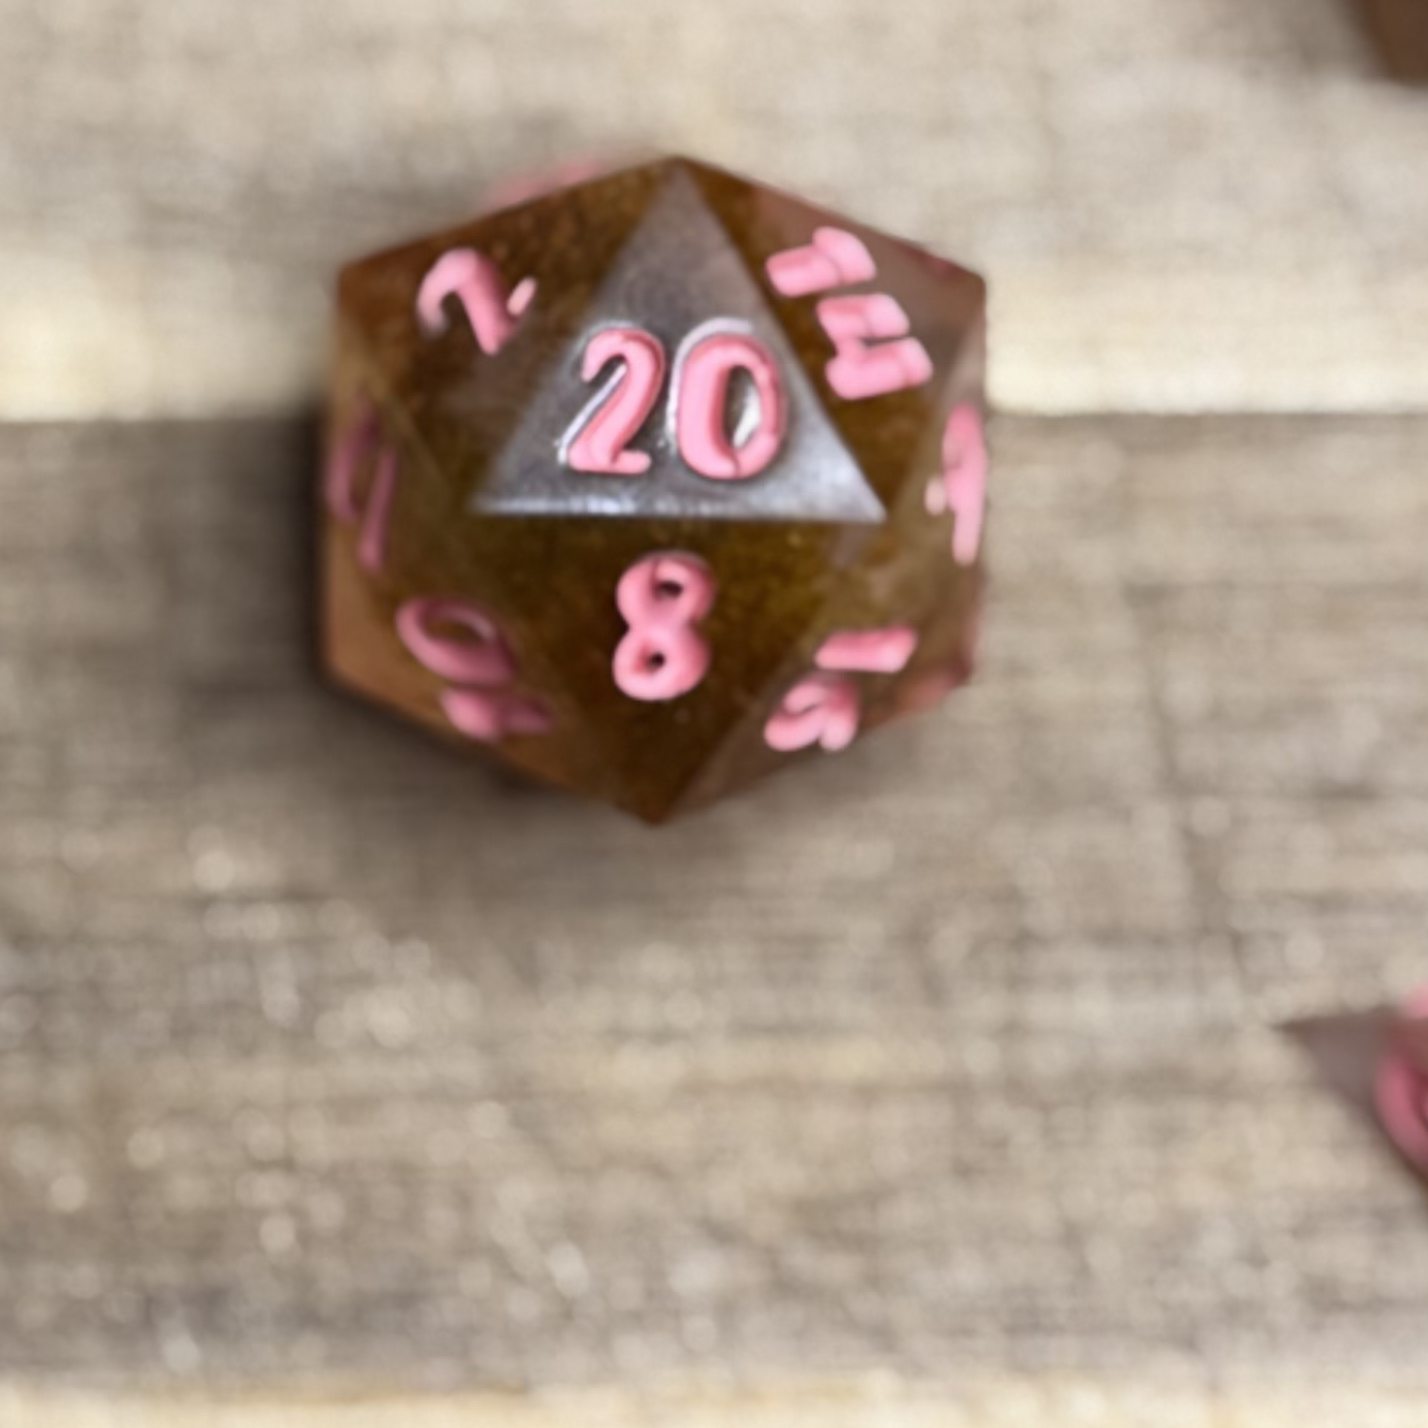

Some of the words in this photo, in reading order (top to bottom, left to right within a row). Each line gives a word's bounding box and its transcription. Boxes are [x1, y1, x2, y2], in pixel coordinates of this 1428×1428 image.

[767, 227, 933, 400] 14
[560, 319, 788, 479] 20
[612, 552, 715, 701] 8
